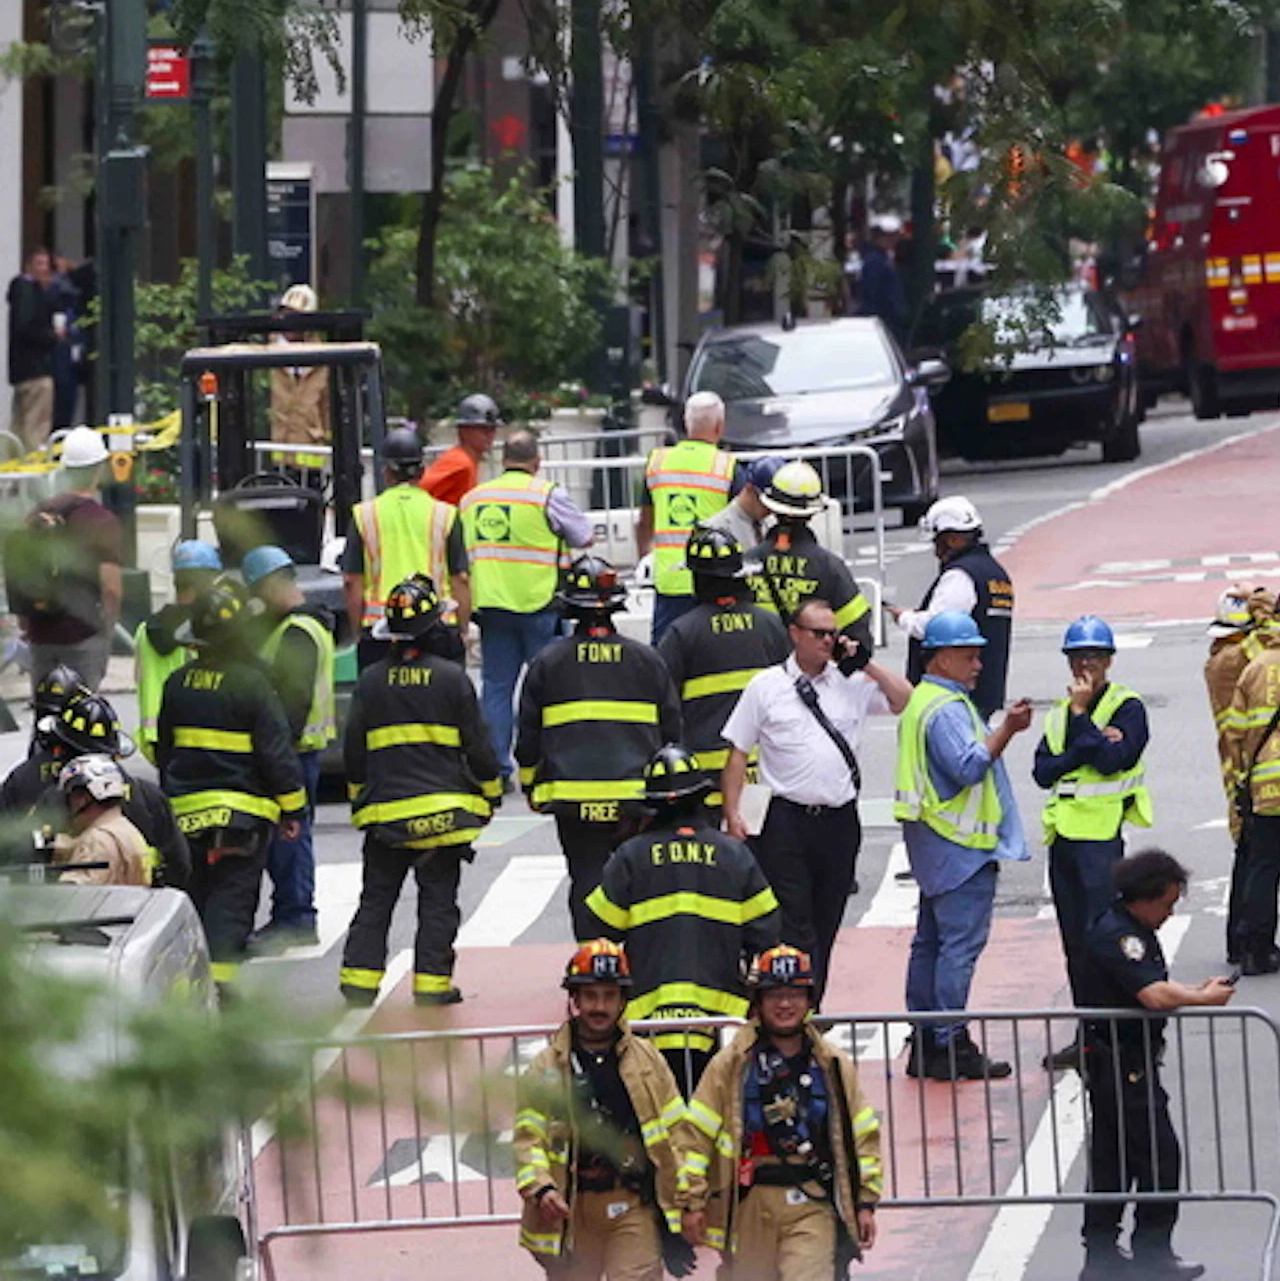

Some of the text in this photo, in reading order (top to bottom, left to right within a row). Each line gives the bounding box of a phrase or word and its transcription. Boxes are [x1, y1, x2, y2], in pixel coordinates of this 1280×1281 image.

[711, 613, 755, 633] FDNY
[577, 642, 623, 663] FDNY
[183, 667, 226, 691] FDNY
[387, 667, 433, 687] FDNY
[580, 802, 620, 823] FREE
[593, 957, 618, 975] HT
[771, 955, 798, 975] HT
